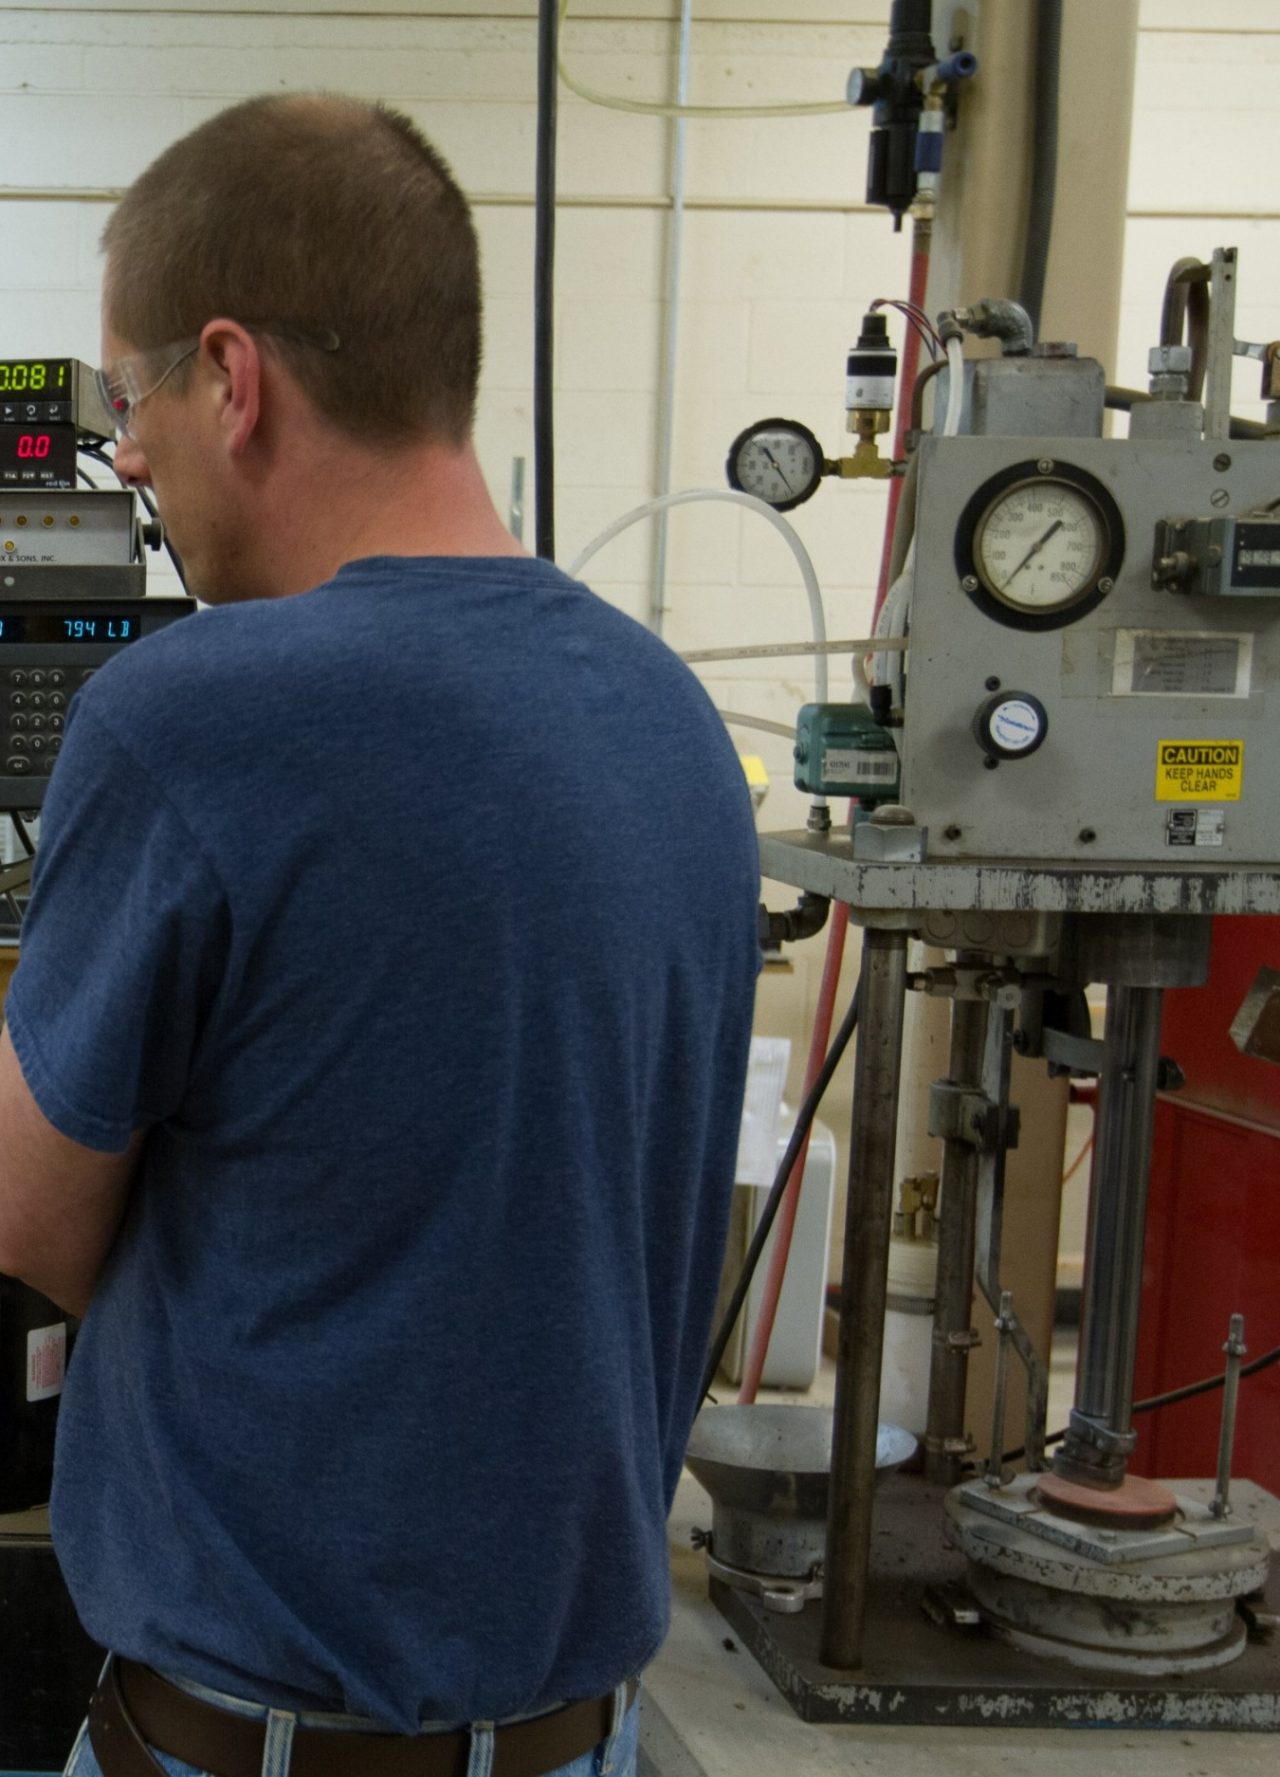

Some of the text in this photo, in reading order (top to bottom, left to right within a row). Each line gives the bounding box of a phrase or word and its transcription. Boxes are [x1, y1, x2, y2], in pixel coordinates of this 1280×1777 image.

[17, 435, 51, 459] 0.0
[1066, 542, 1081, 551] 700
[992, 551, 1006, 560] 100
[63, 620, 95, 637] 794
[15, 696, 21, 704] 4
[34, 718, 40, 726] 2
[53, 718, 59, 726] 3
[34, 739, 40, 748] 0
[1164, 748, 1237, 763] CAUTION
[1165, 768, 1233, 780] KEEP HANDS
[1180, 780, 1216, 793] CLEAR
